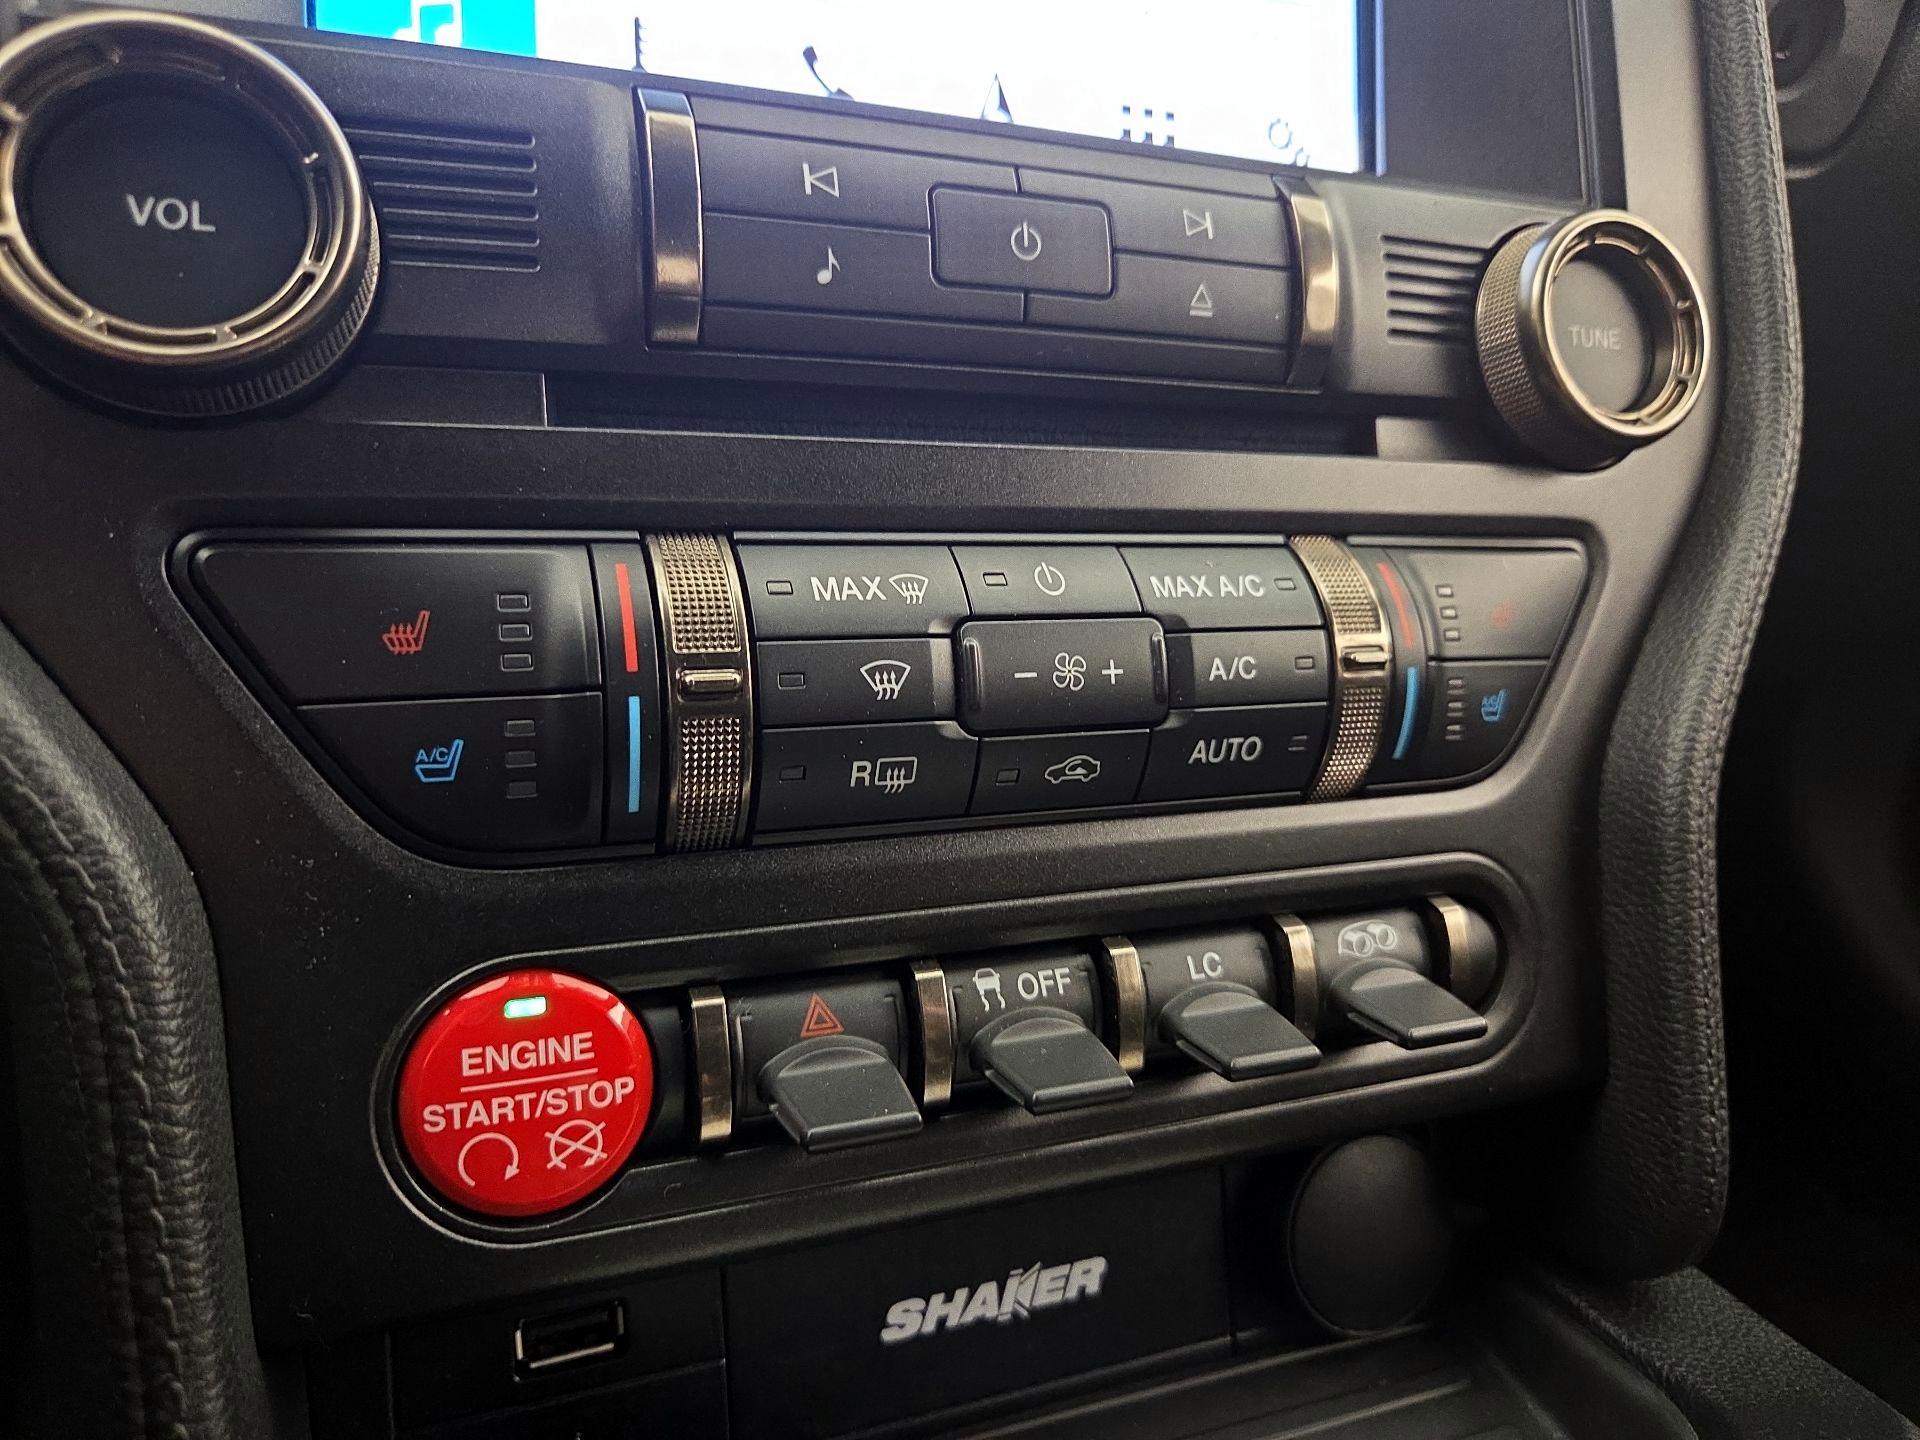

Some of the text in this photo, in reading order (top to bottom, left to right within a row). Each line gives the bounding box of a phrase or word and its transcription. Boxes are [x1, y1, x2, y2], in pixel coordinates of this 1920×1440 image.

[126, 193, 217, 233] VOL
[1567, 323, 1622, 351] TUNE
[810, 576, 888, 602] MAX
[1149, 574, 1265, 599] MAX A/C
[1208, 655, 1257, 682] A/C
[415, 746, 449, 763] A/C
[1187, 735, 1262, 765] AUTO
[849, 760, 872, 788] R
[1186, 951, 1222, 980] LC
[1017, 967, 1071, 1000] OFF
[461, 1031, 595, 1078] ENGINE
[422, 1076, 635, 1134] START/STOP
[880, 1256, 1107, 1344] SHAKER
